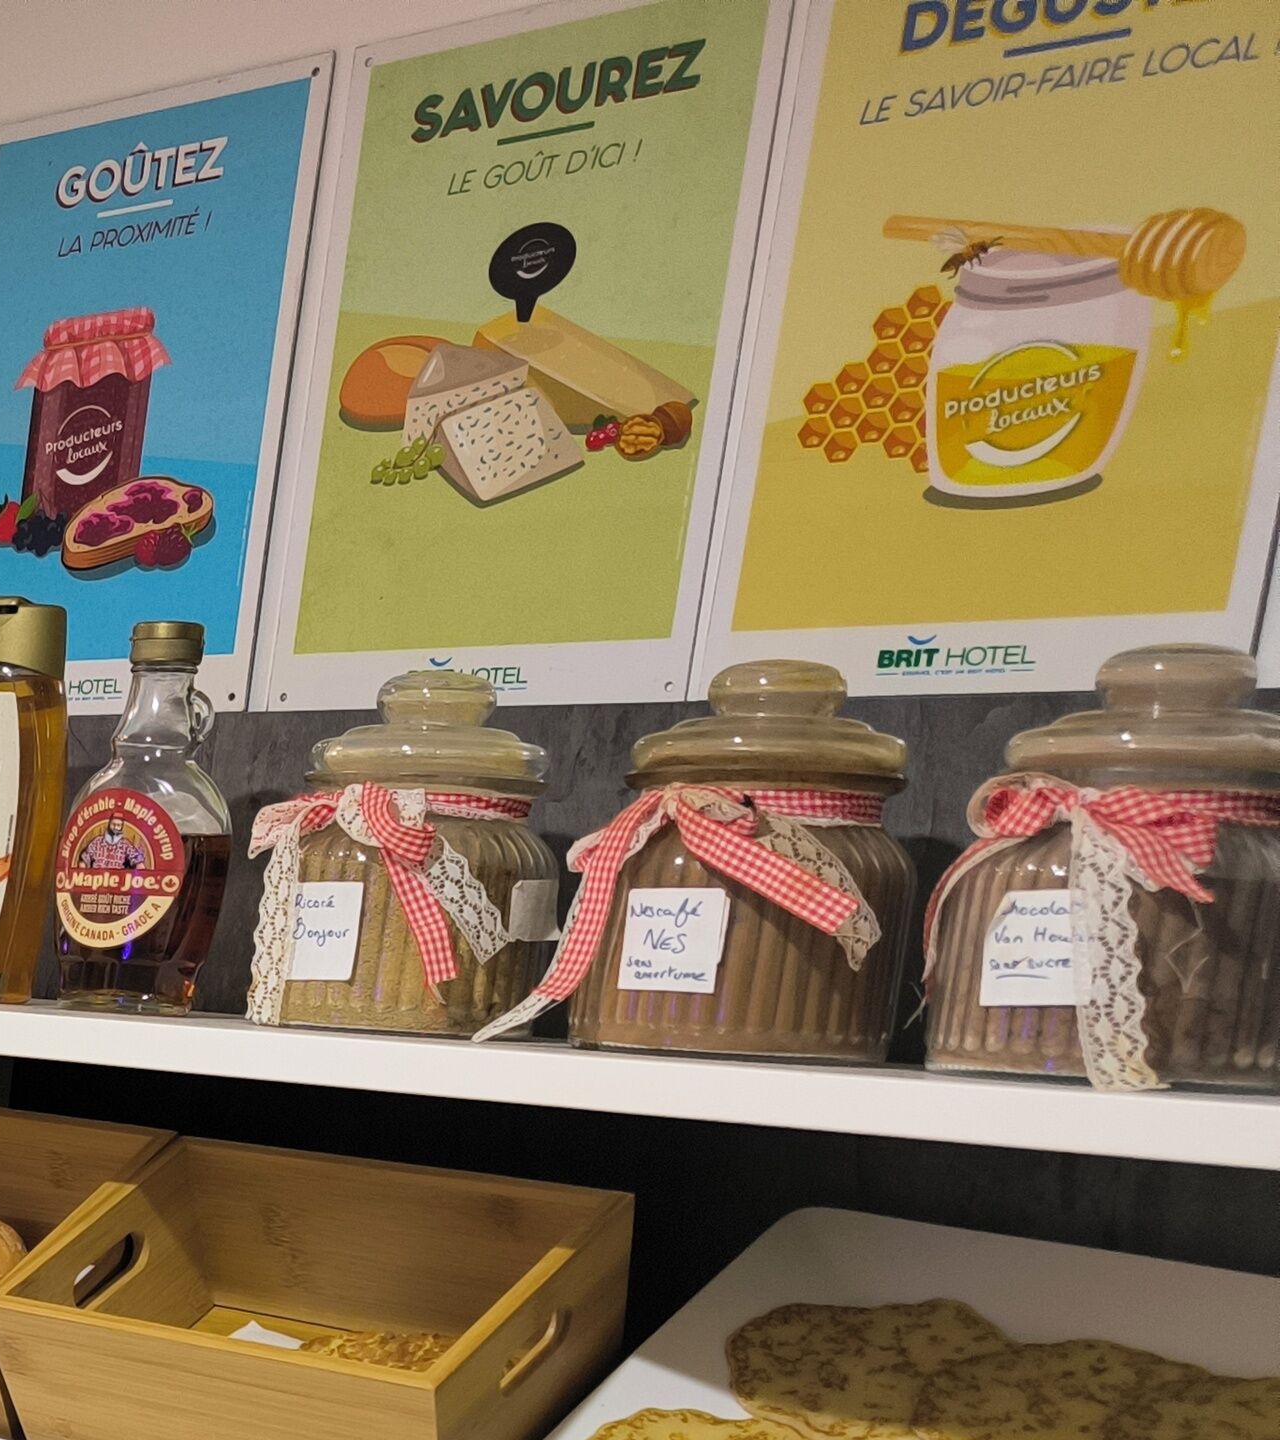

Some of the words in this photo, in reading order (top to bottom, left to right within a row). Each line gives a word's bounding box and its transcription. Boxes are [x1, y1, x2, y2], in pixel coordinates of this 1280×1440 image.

[410, 38, 707, 143] SAVOUREZ
[859, 95, 897, 126] LE
[904, 52, 1135, 117] SAVOIR-FAIRE
[1142, 33, 1260, 77] LOCAL
[56, 136, 229, 208] GOÛTEZ
[447, 169, 477, 196] LE
[483, 151, 561, 189] GOÛT
[565, 140, 626, 175] D'ICI
[58, 234, 83, 258] LA
[90, 206, 200, 252] PROXIMITÉ
[877, 648, 940, 669] BRIT
[945, 645, 1036, 667] HOTEL
[68, 678, 123, 695] HOTEL
[124, 797, 158, 826] Maple
[65, 871, 120, 891] Maple
[295, 893, 335, 909] Ricoré
[630, 898, 703, 928] Nescafé
[80, 925, 115, 942] CANADA
[121, 910, 154, 937] GRADE
[292, 917, 350, 947] Bonjour
